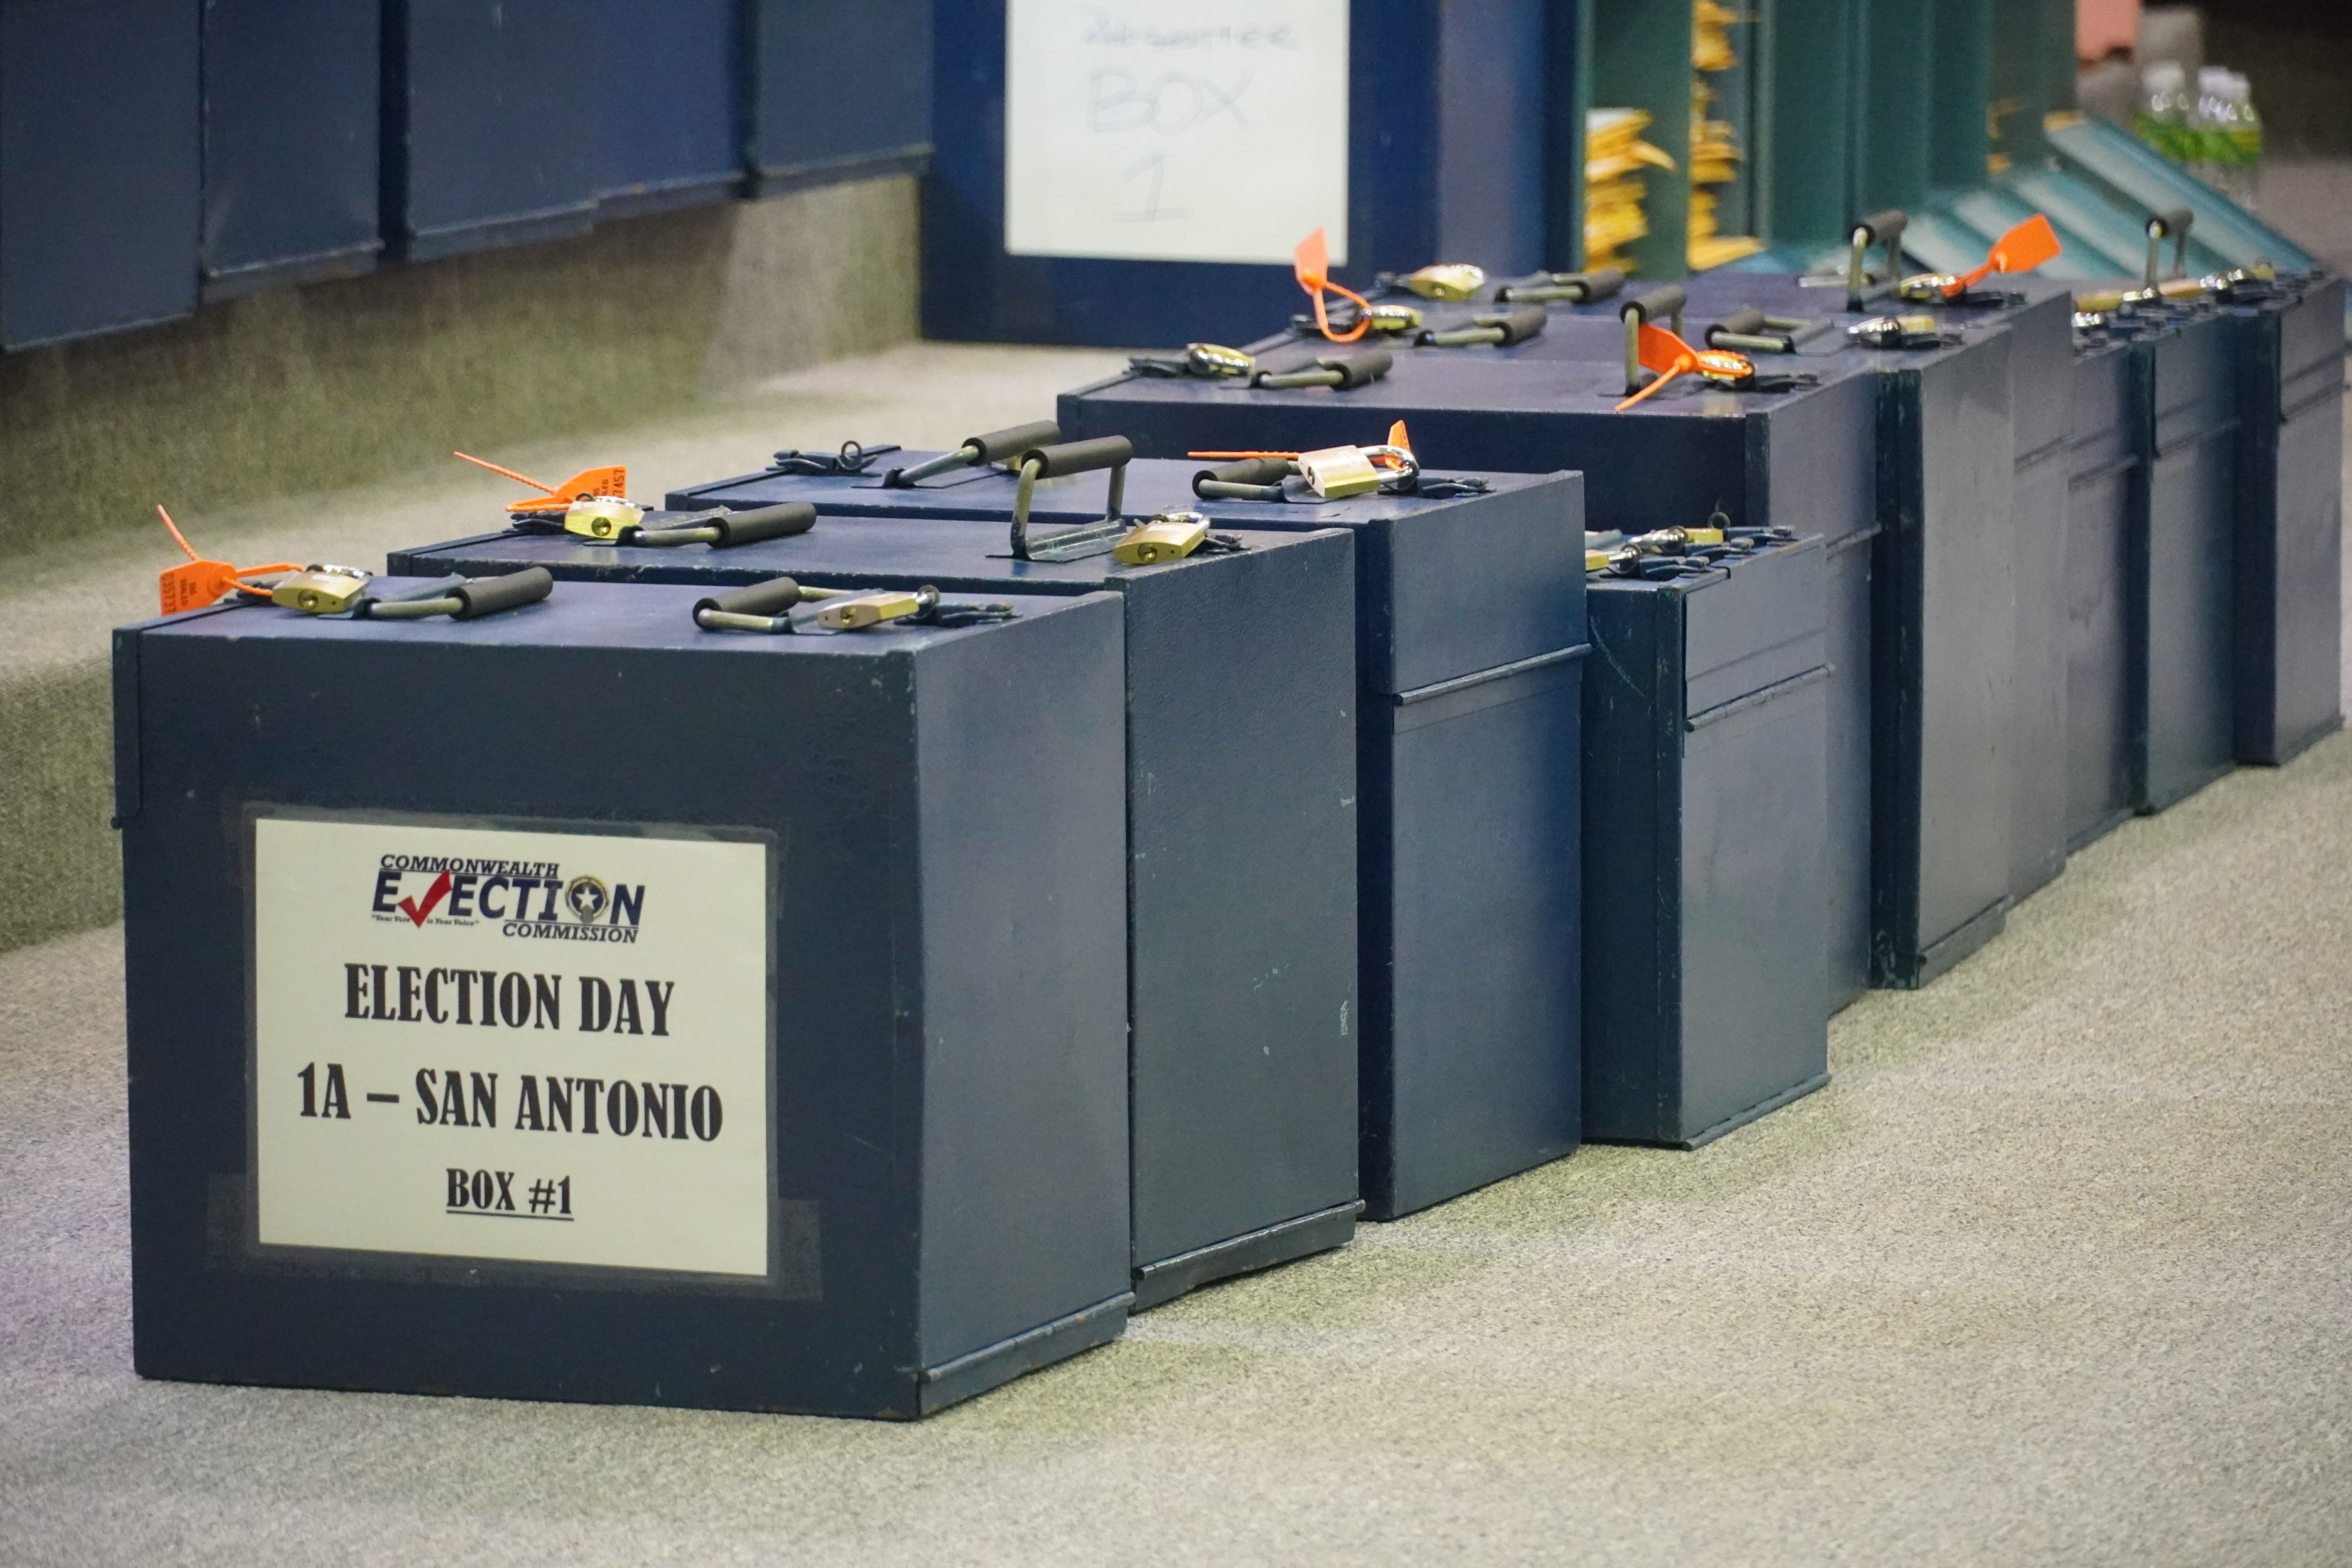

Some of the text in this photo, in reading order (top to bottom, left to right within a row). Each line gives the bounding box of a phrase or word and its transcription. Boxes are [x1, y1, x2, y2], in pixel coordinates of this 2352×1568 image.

[1087, 65, 1254, 136] BOX
[1114, 149, 1192, 223] 1
[381, 854, 560, 879] COMMONWEALTH
[503, 922, 639, 943] COMMISSION
[345, 963, 674, 1036] ELECTION DAY
[298, 1062, 351, 1119] 1A
[416, 1068, 498, 1128] SAN
[515, 1075, 722, 1142] ANTONIO
[446, 1168, 571, 1214] BOX #1
